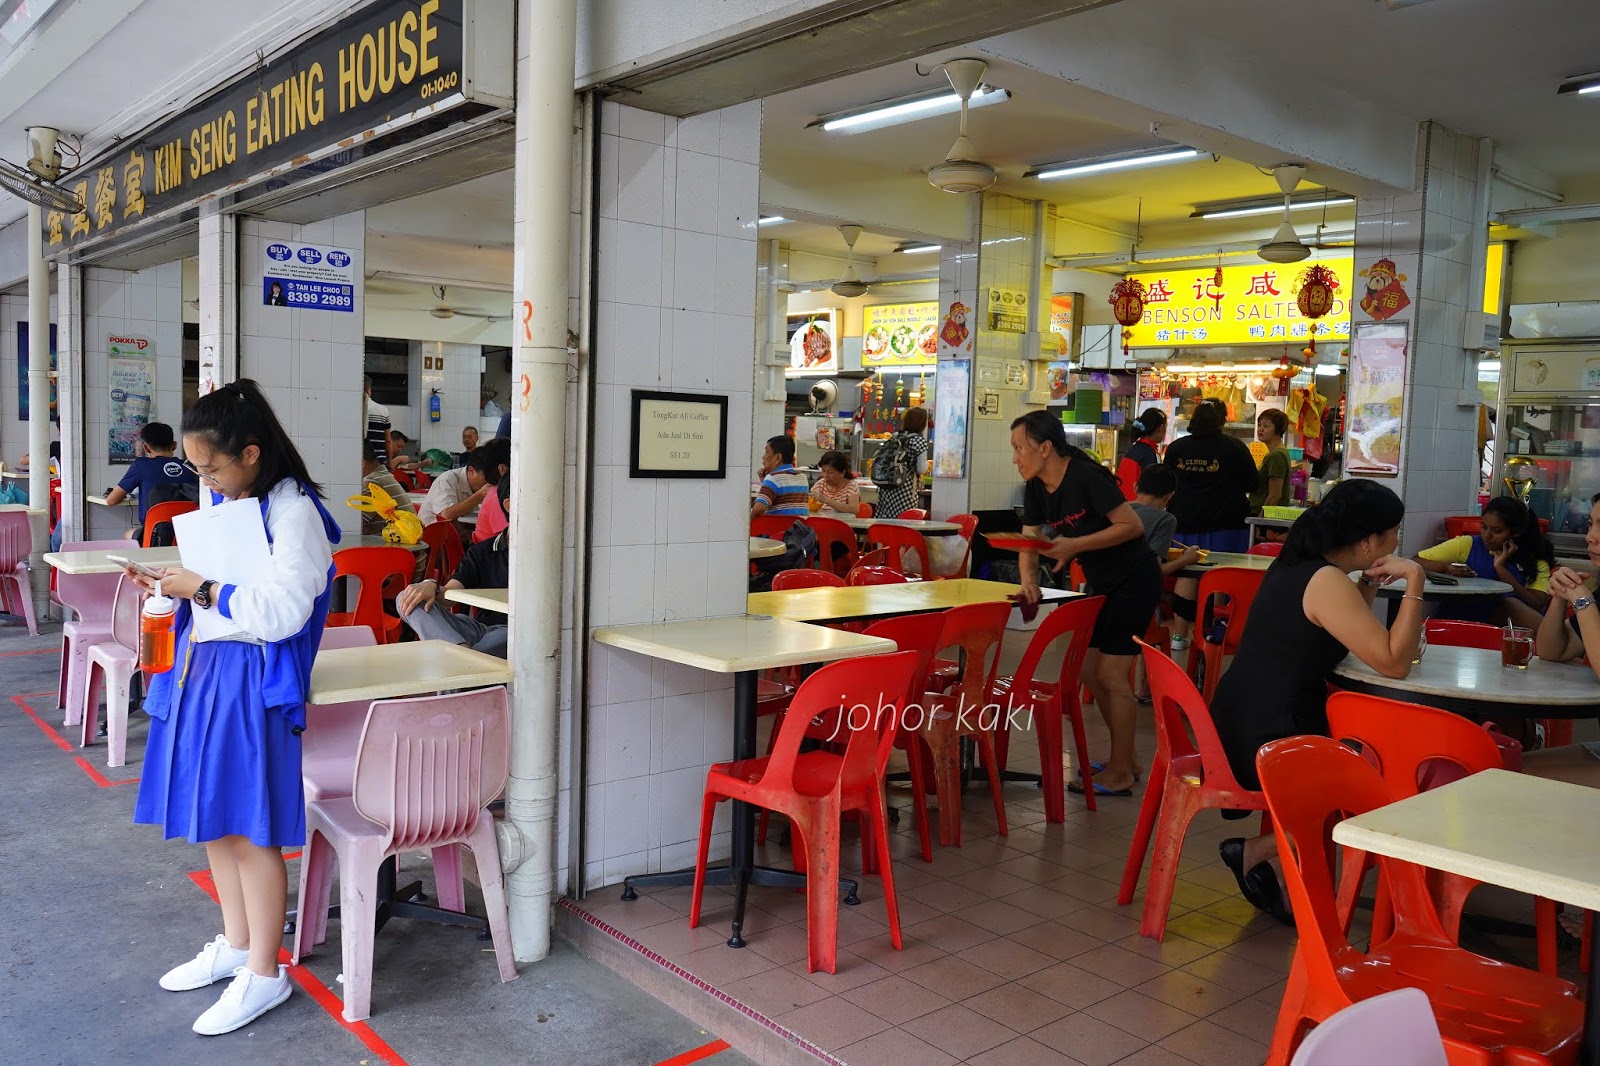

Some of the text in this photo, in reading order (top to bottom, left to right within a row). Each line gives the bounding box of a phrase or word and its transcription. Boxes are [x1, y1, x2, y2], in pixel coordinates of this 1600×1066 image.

[421, 71, 458, 99] 01-1040
[154, 0, 439, 195] KIM SENG EATING HOUSE
[270, 246, 288, 254] BUY
[300, 249, 321, 258] SELL
[329, 253, 348, 261] RENT
[295, 283, 309, 291] TAN
[287, 291, 351, 306] 8399 2989
[1381, 290, 1401, 309] 福
[1143, 306, 1222, 324] BENSON
[1237, 301, 1299, 320] SALTE
[109, 336, 136, 345] POKKA
[652, 410, 709, 421] TongKat Ali Coffee
[656, 431, 669, 439] Ada
[683, 432, 691, 440] Di
